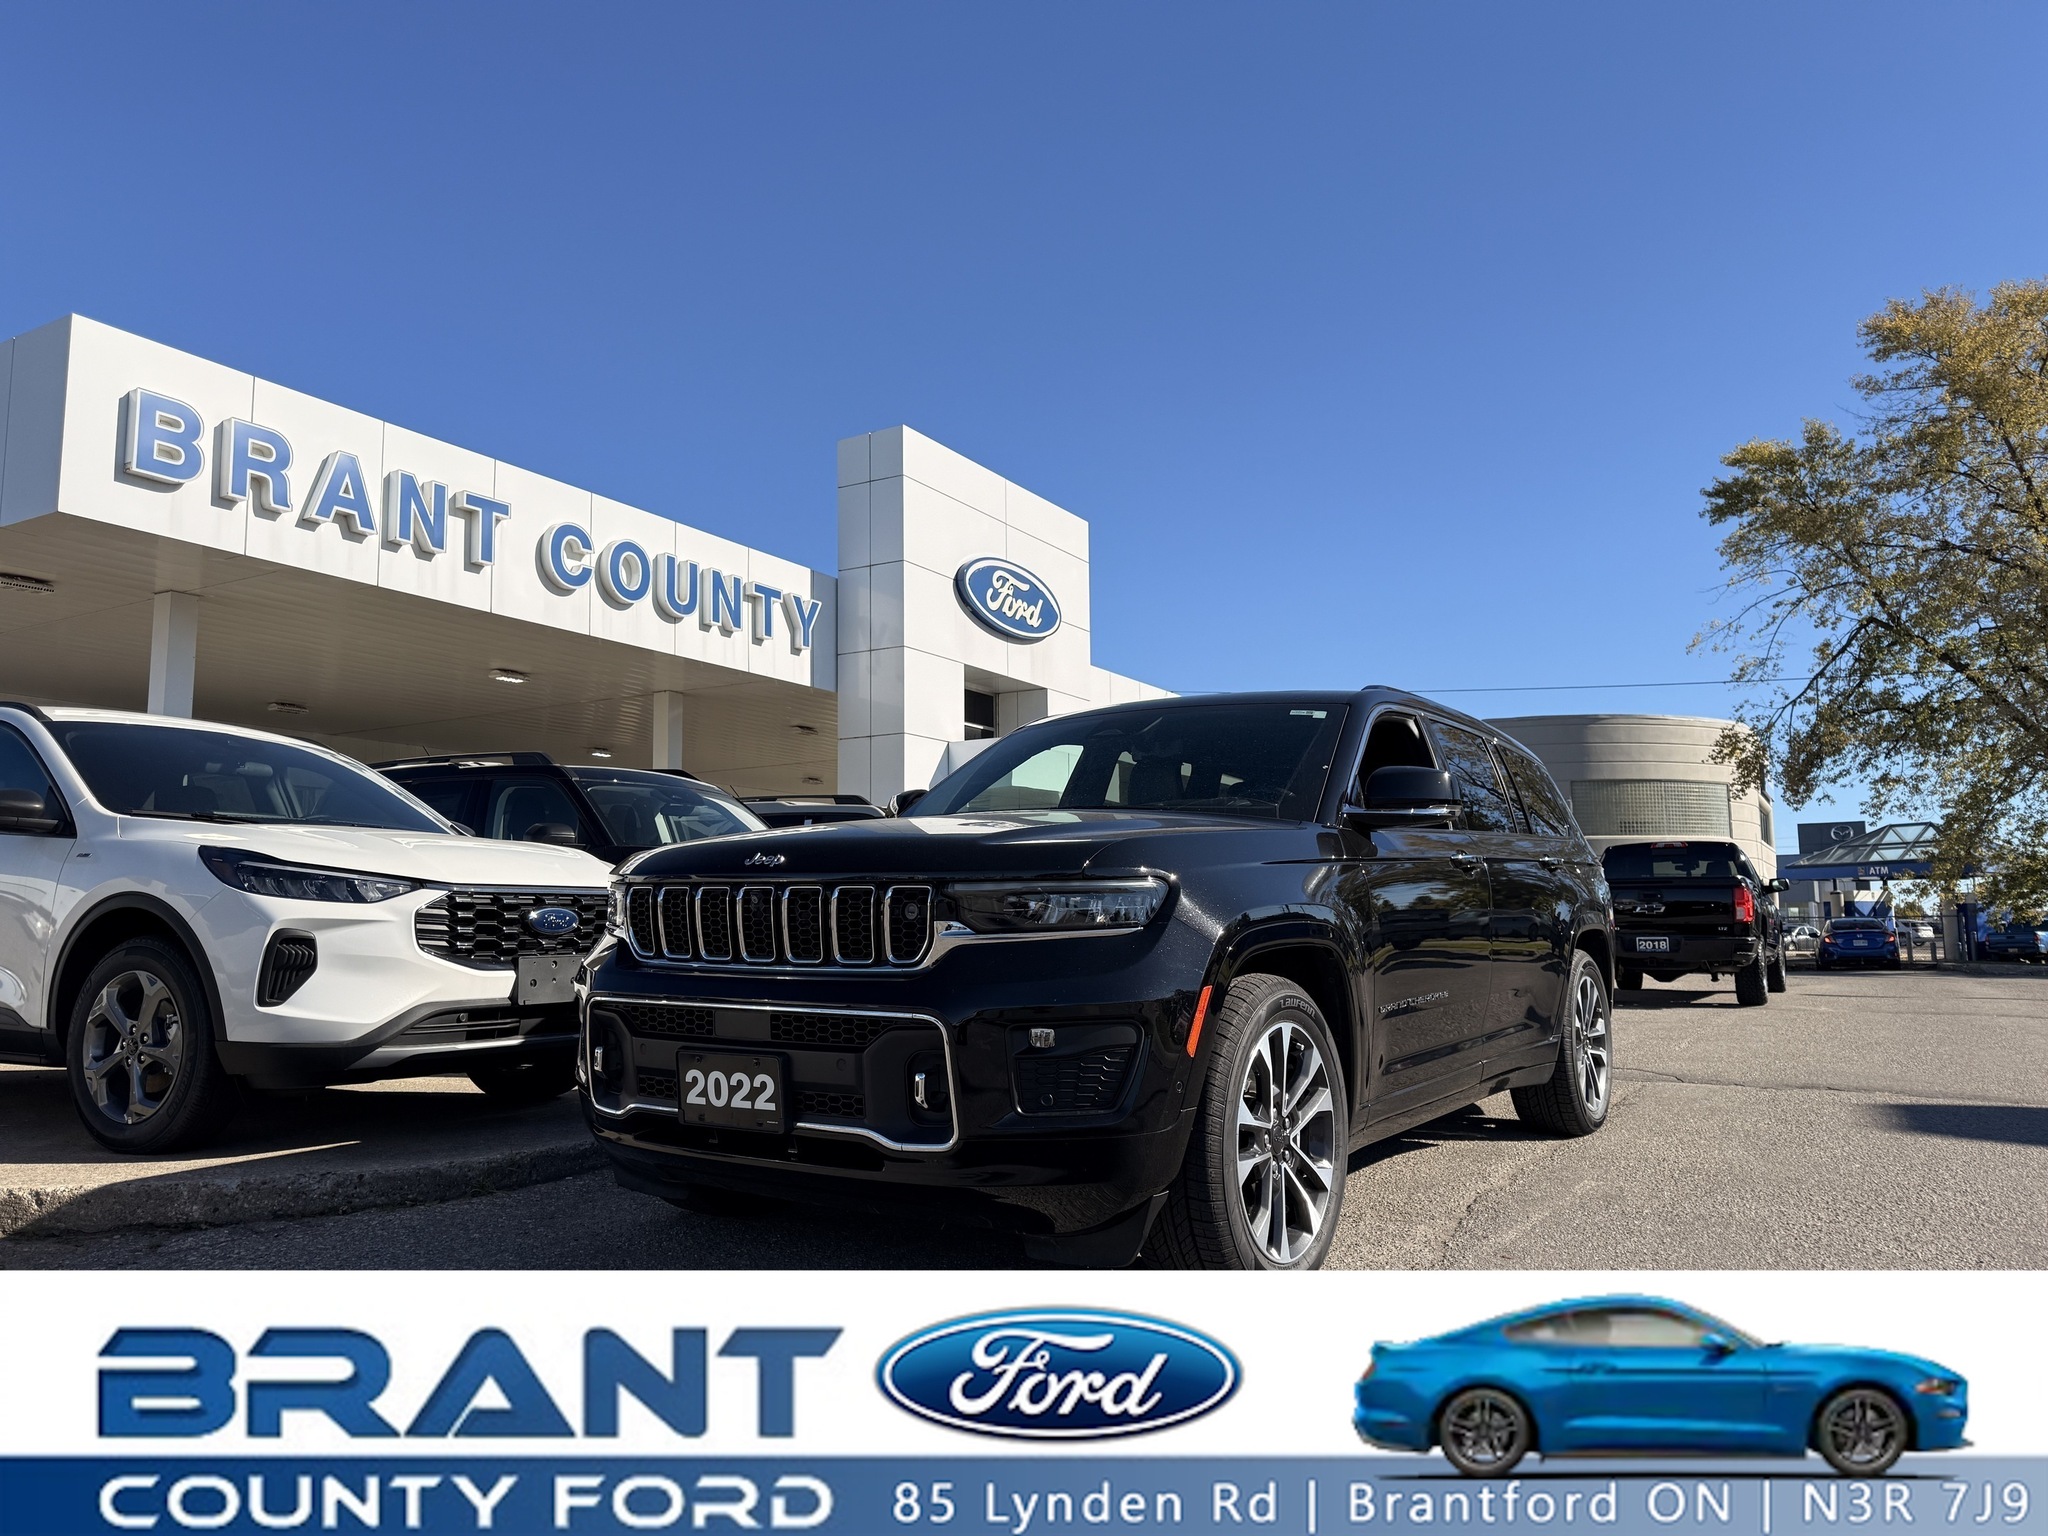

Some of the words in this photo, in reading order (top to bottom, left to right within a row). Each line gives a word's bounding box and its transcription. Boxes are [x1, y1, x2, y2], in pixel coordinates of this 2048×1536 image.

[122, 386, 511, 567] BRANT
[538, 521, 822, 651] COUNTY
[986, 569, 1044, 628] Ford
[744, 852, 785, 867] Jeep
[1869, 866, 1889, 875] ATM
[1638, 940, 1667, 950] 2018
[685, 1069, 776, 1111] 2022
